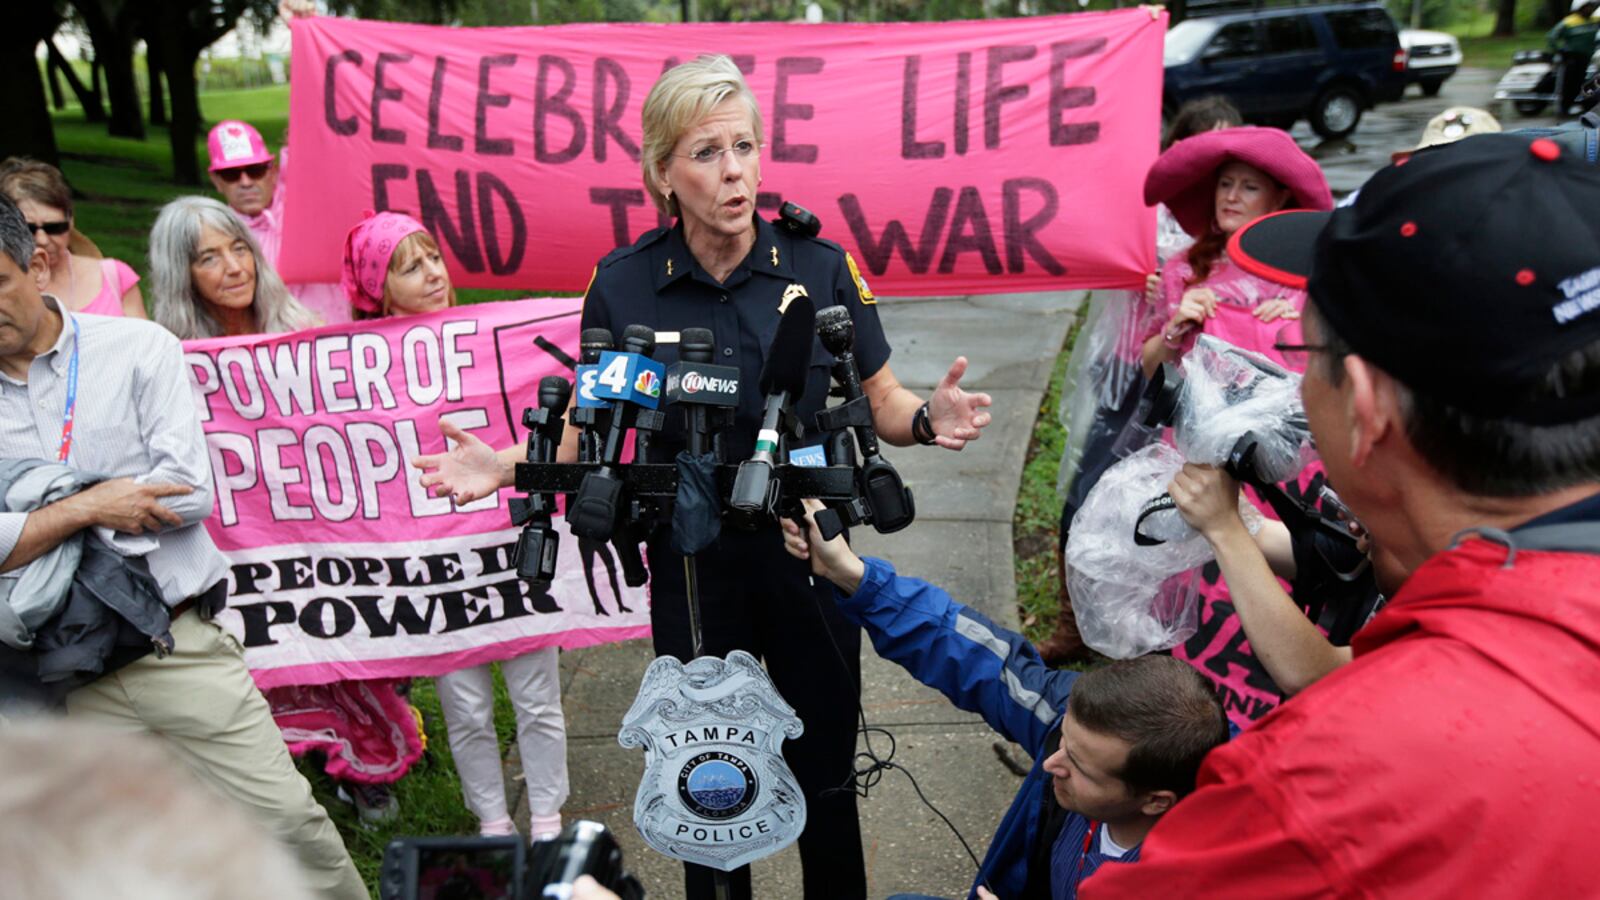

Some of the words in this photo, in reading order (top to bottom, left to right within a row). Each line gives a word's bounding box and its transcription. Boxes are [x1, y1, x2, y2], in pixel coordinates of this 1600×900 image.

[324, 50, 825, 164] CELEBRE
[902, 37, 1108, 159] LIFE
[837, 177, 1068, 277] WAR
[184, 332, 397, 423] POWER
[402, 319, 478, 405] OF
[599, 355, 629, 394] 4
[230, 556, 465, 597] PEOPLE
[228, 578, 564, 648] POWER
[665, 726, 756, 749] TAMPA
[680, 760, 697, 779] CITY
[698, 752, 711, 762] OF
[717, 752, 748, 772] TAMPA
[675, 819, 771, 843] POLICE
